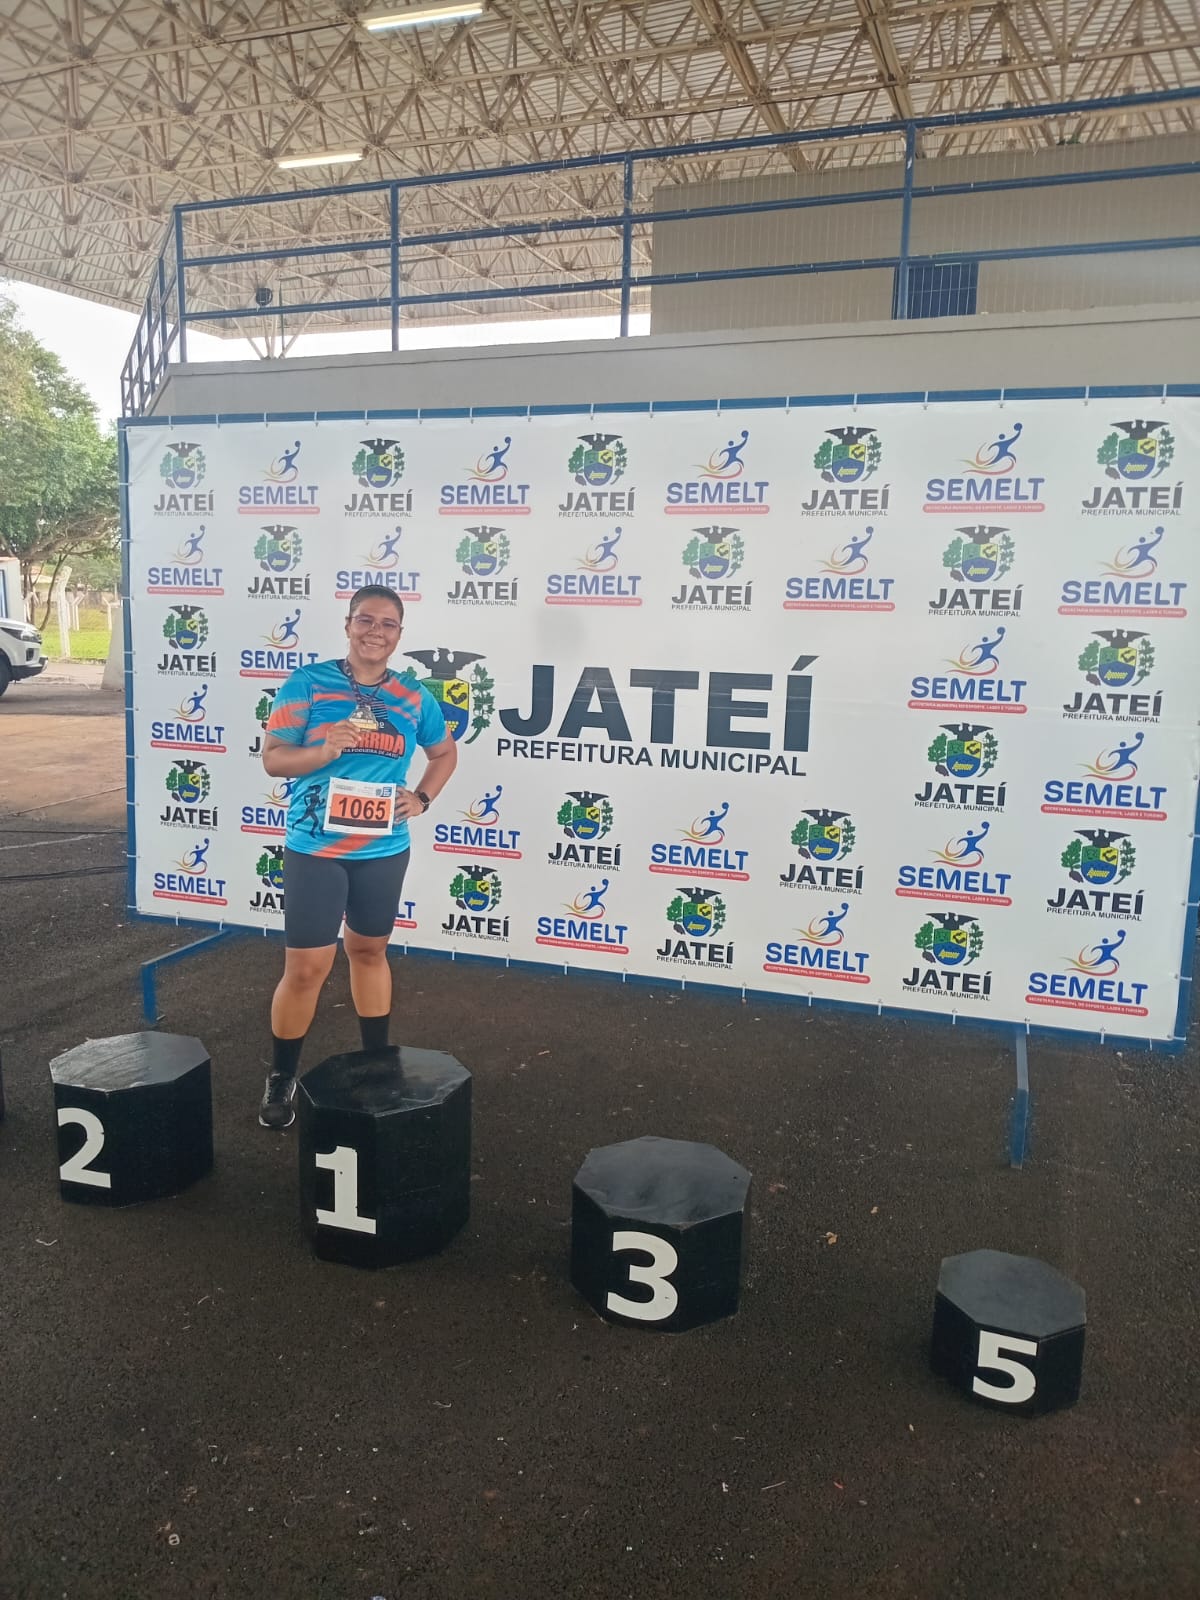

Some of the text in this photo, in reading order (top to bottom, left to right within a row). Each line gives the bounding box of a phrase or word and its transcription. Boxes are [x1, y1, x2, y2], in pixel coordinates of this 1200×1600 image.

[155, 489, 213, 511] JATEÍ
[240, 486, 319, 505] SEMELT
[345, 489, 413, 511] JATEÍ
[441, 484, 530, 505] SEMELT
[559, 487, 636, 511] JATEÍ
[667, 481, 769, 504] SEMELT
[802, 484, 890, 510] JATEÍ
[925, 478, 1045, 501] SEMELT
[1082, 482, 1184, 509] JATEÍ
[148, 567, 223, 587] SEMELT
[248, 574, 310, 596] JATEÍ
[336, 571, 420, 591] SEMELT
[448, 578, 518, 599] JATEÍ
[548, 575, 642, 595] SEMELT
[672, 582, 753, 605] JATEÍ
[786, 578, 896, 601] SEMELT
[929, 585, 1024, 610] JATEÍ
[1061, 580, 1188, 605] SEMELT
[158, 652, 216, 672] JATEÍ
[911, 676, 1028, 702] SEMELT
[499, 655, 820, 753] JATEÍ
[1063, 692, 1163, 715] JATEÍ
[1063, 712, 1160, 722] PREFEITURA MUNICIPAL
[152, 721, 226, 744] SEMELT
[497, 738, 807, 776] PREFEITURA MUNICIPAL
[915, 782, 1008, 806] JATEÍ
[1044, 780, 1168, 810] SEMELT
[160, 806, 218, 826] JATEÍ
[339, 797, 386, 820] 1065
[915, 800, 1004, 812] PREFEITURA MUNICIPAL
[434, 824, 521, 850] SEMELT
[548, 843, 621, 865] JATEÍ
[548, 860, 620, 871] PREFEITURA MUNICIPAL
[651, 843, 750, 871] SEMELT
[154, 872, 226, 897] SEMELT
[780, 864, 864, 888] JATEÍ
[897, 865, 1012, 895] SEMELT
[779, 882, 862, 894] PREFEITURA MUNICIPAL
[250, 891, 285, 910] JAT
[1047, 888, 1145, 915] JATEÍ
[442, 914, 509, 936] JATEÍ
[1047, 907, 1142, 921] PREFEITURA MUNICIPAL
[442, 930, 509, 942] PREFEITURA MUNICIPAL
[537, 916, 631, 945] SEMELT
[657, 939, 734, 963] JATEÍ
[657, 955, 732, 969] PREFEITURA MUNICIPAL
[766, 942, 871, 973] SEMELT
[903, 968, 993, 994] JATEÍ
[1028, 972, 1149, 1006] SEMELT
[903, 986, 990, 1000] PREFEITURA MUNICIPAL
[57, 1107, 111, 1189] 2
[315, 1145, 377, 1235] 1
[606, 1231, 679, 1322] 3
[972, 1330, 1038, 1404] 5
